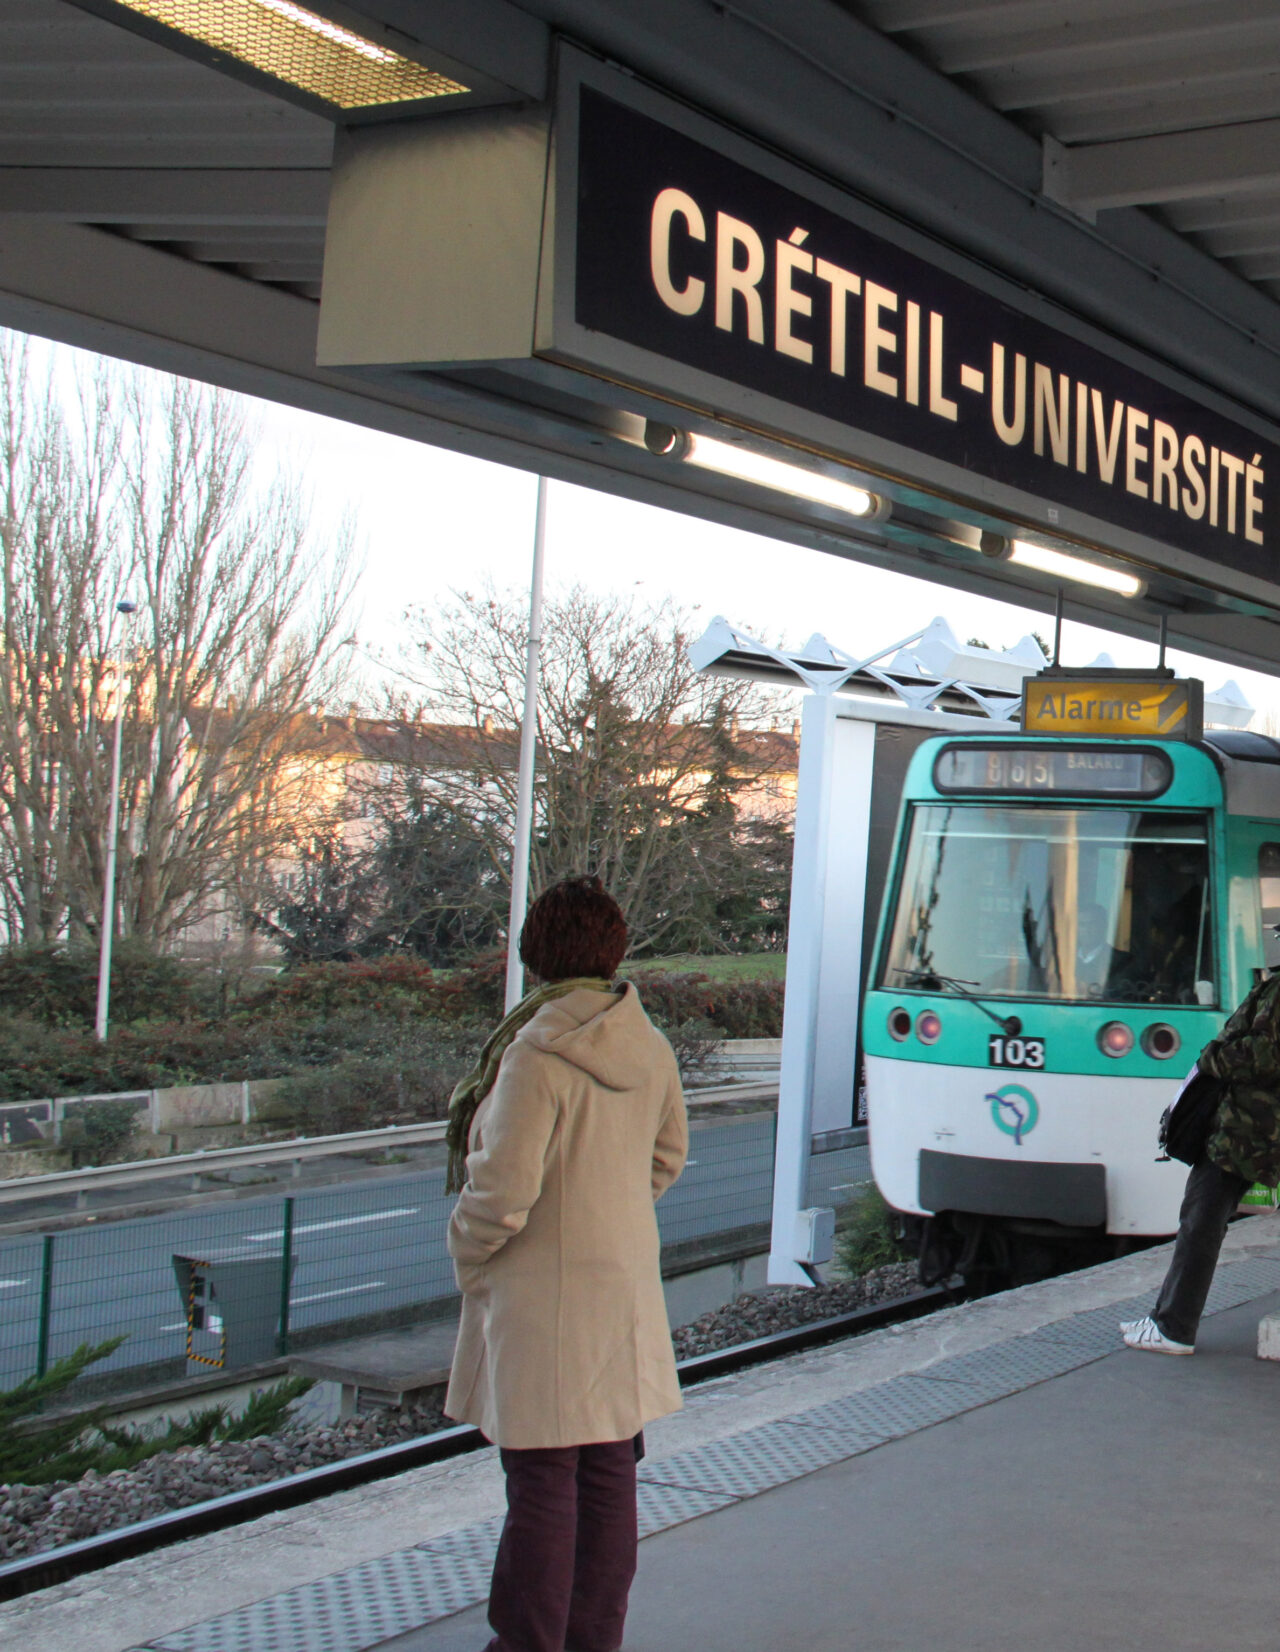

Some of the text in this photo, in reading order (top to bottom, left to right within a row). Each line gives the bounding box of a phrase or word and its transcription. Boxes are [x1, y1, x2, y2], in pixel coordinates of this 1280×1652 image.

[651, 187, 1264, 546] CRÉTEIL-UNIVERSITÉ
[1037, 693, 1143, 721] Alarme
[989, 1038, 1045, 1067] 103
